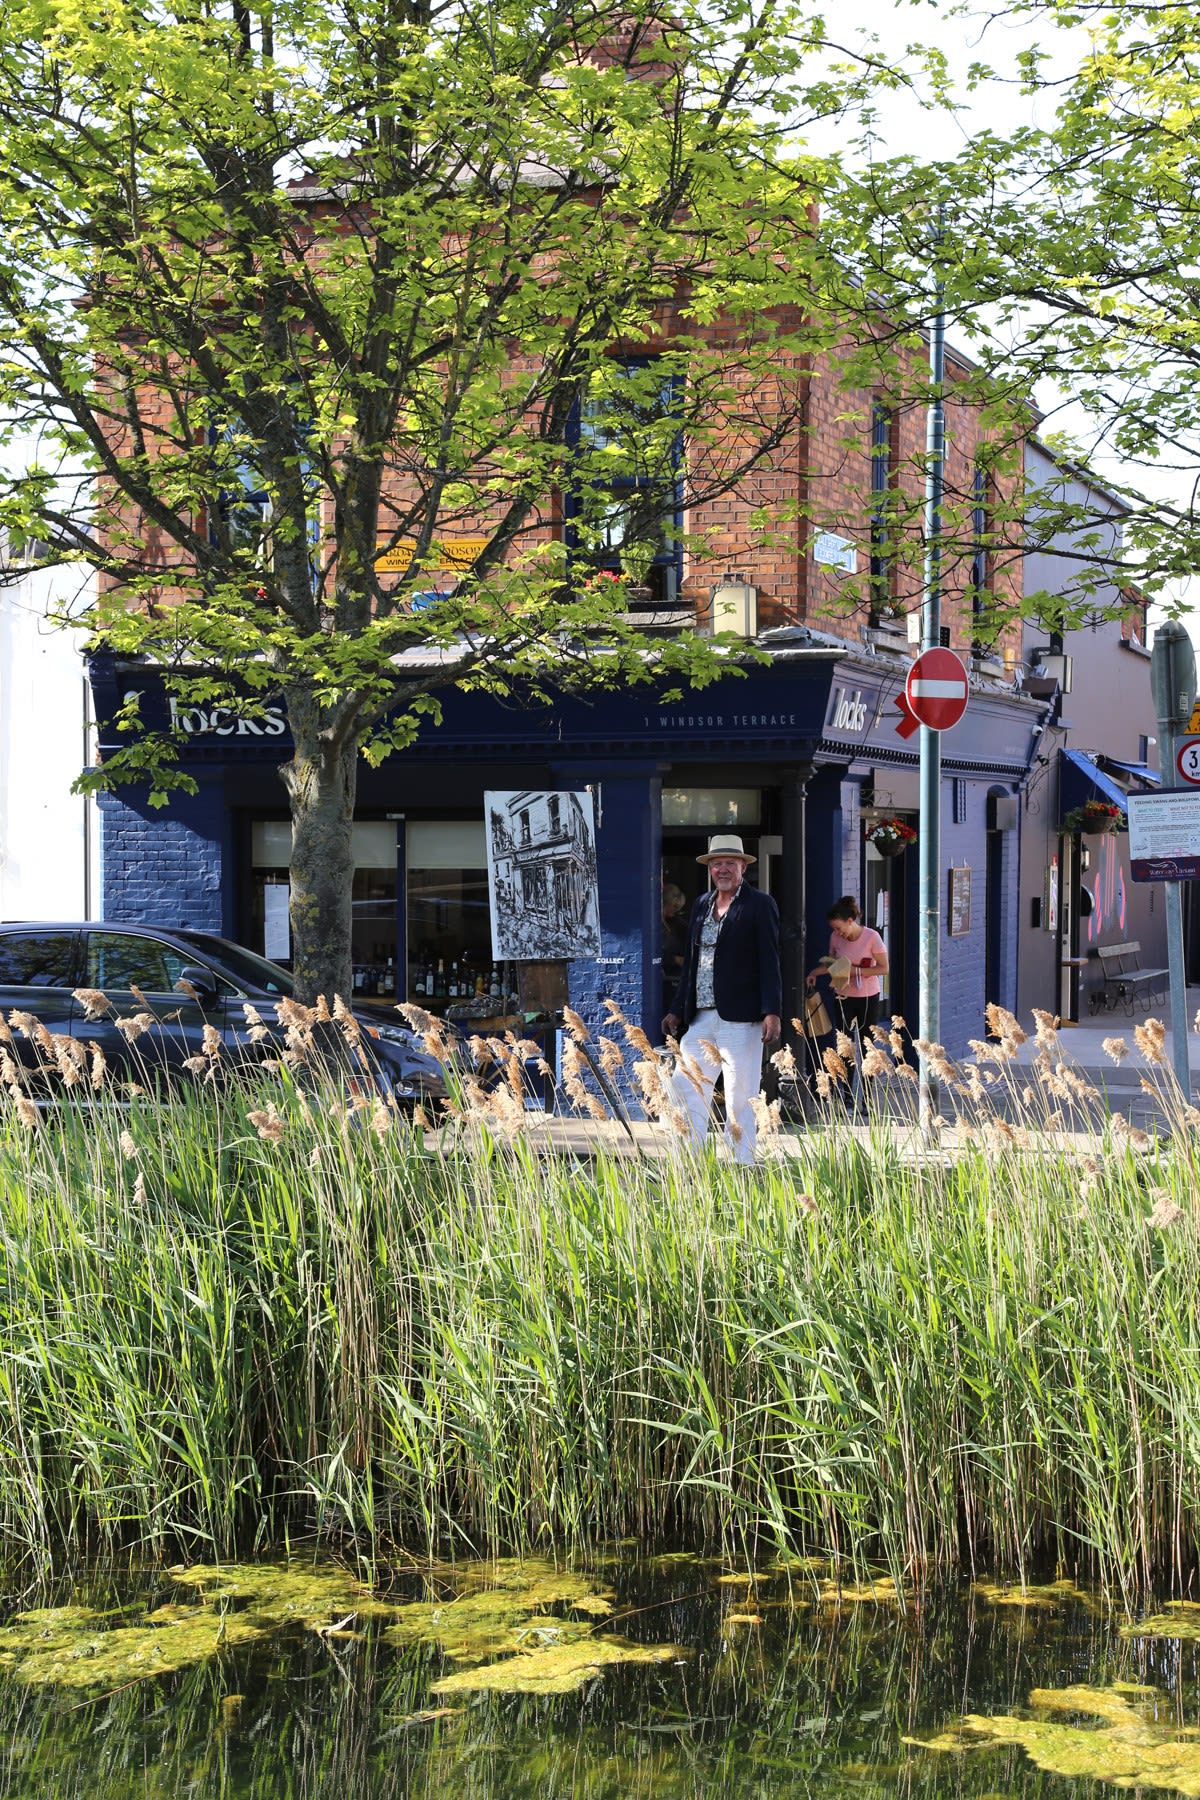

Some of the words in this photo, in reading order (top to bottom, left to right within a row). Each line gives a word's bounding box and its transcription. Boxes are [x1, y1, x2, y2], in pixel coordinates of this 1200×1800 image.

[168, 696, 286, 736] locks
[660, 716, 724, 727] WINDSOR
[733, 714, 796, 726] TERRACE
[832, 687, 868, 732] locks
[1188, 750, 1198, 769] 3
